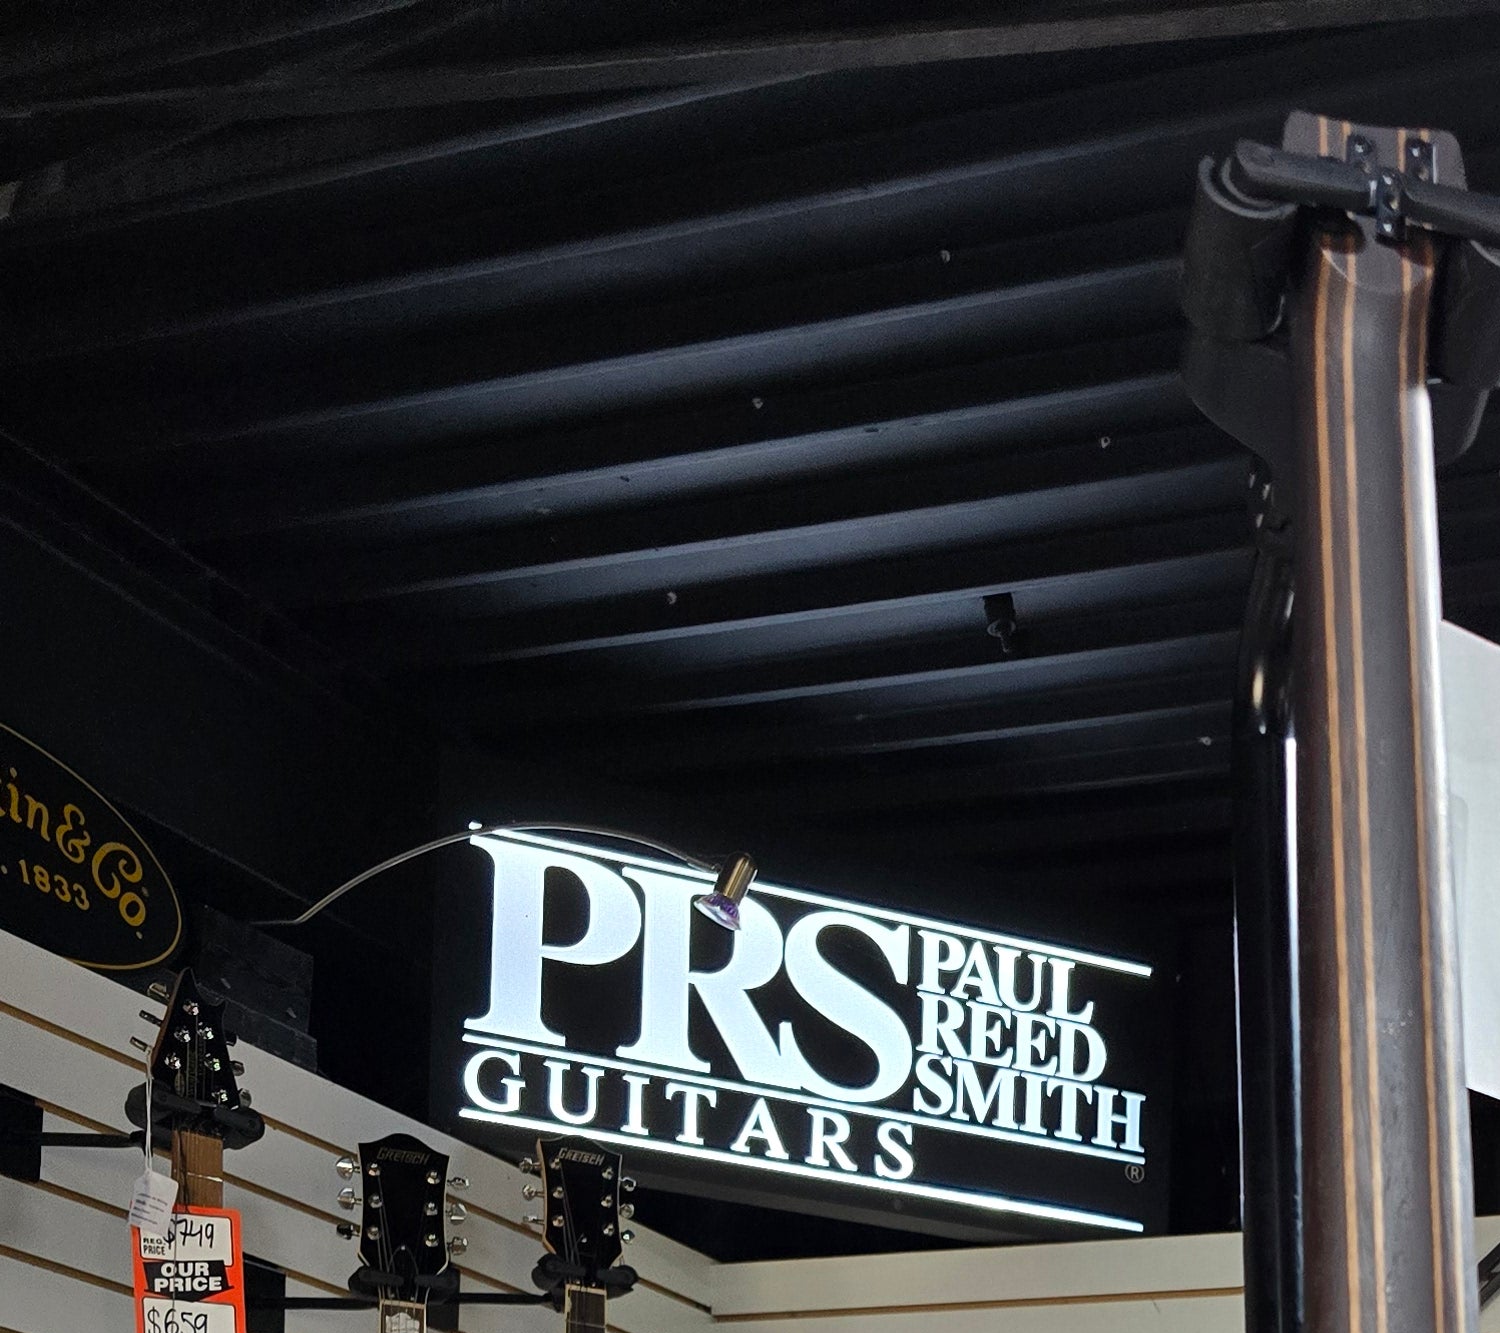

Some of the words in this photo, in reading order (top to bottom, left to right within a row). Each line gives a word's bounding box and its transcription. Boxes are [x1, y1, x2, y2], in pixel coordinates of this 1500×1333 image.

[19, 859, 90, 911] 1833
[464, 834, 913, 1103] PRS
[919, 929, 1095, 1024] PAUL
[917, 992, 1107, 1083] REED
[462, 1048, 915, 1180] GUITARS
[912, 1053, 1147, 1154] SMITH
[376, 1146, 430, 1166] GRETSCH
[558, 1147, 605, 1167] GRETSCH
[143, 1245, 166, 1256] PRICE
[164, 1217, 215, 1250] $749
[153, 1276, 223, 1293] PRICE
[160, 1262, 210, 1277] OUR
